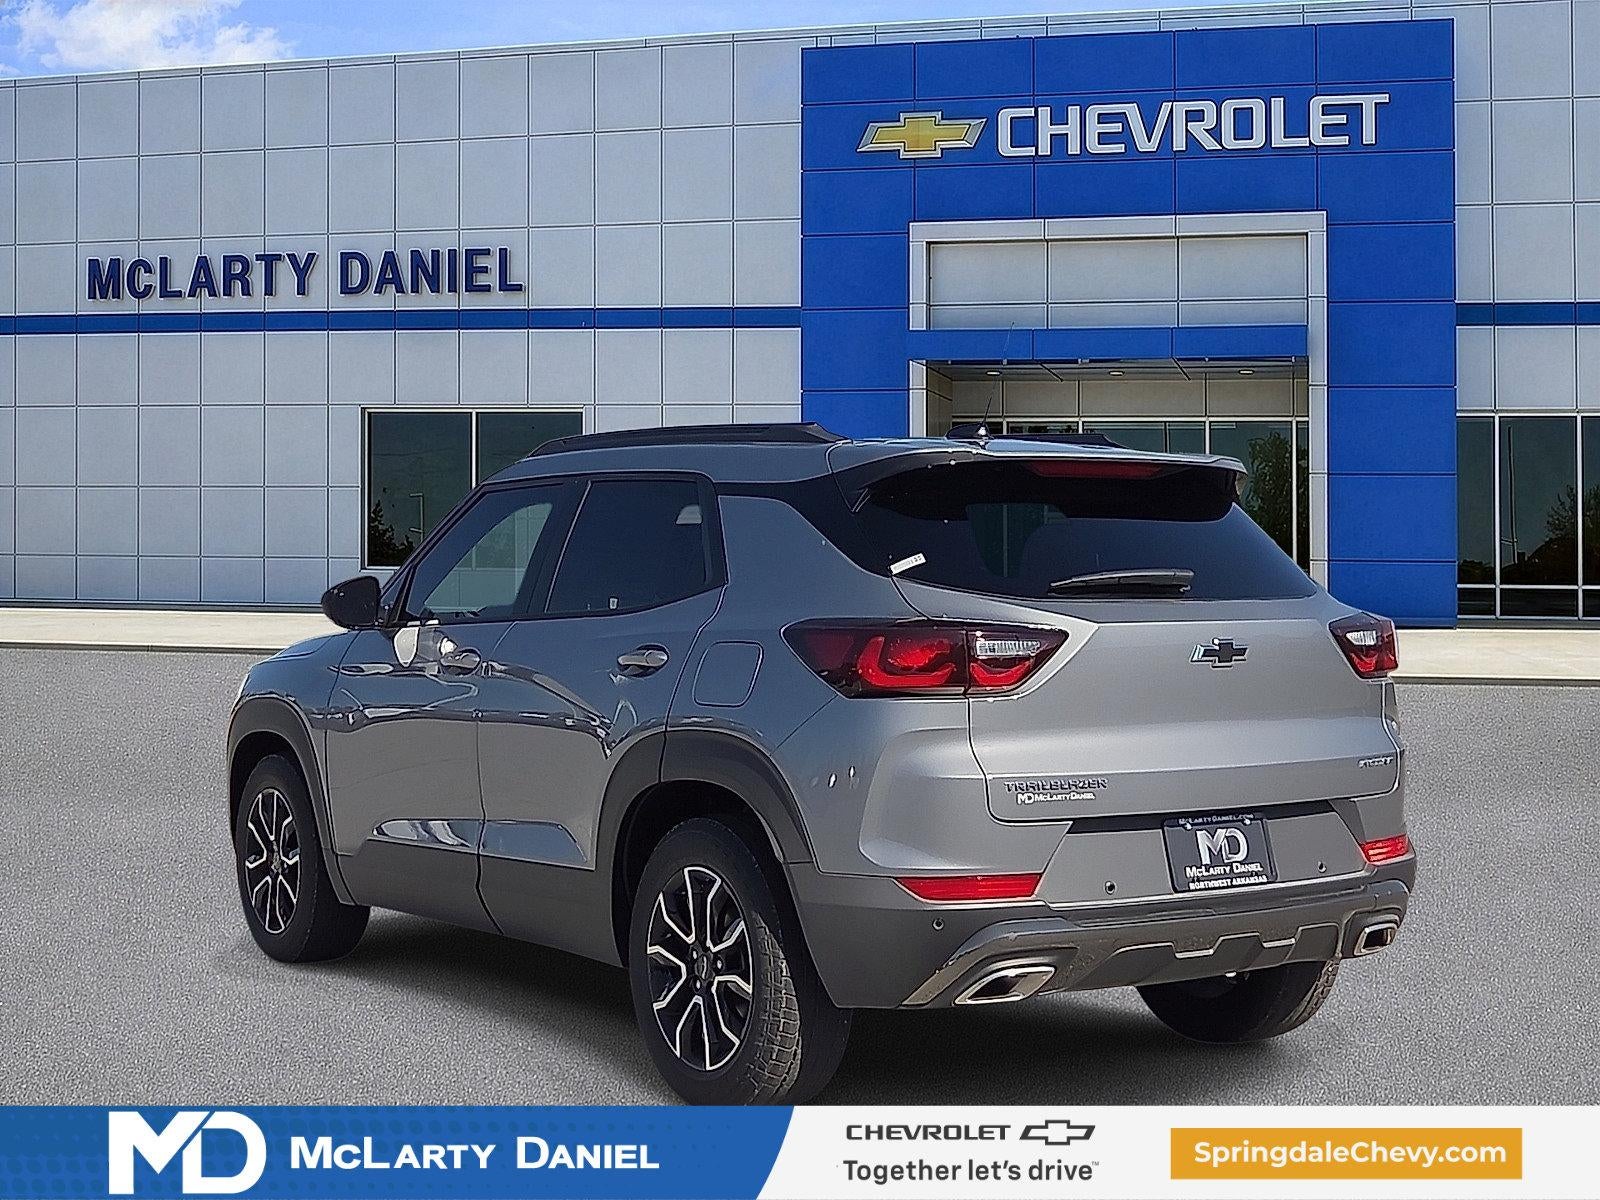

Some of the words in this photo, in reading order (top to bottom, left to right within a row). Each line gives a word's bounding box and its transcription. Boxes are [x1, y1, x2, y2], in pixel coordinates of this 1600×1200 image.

[996, 93, 1389, 157] CHEVROLET
[339, 246, 525, 295] DANIEL
[1004, 778, 1108, 793] TRAILBLAZER
[1196, 828, 1249, 865] MD
[1232, 862, 1263, 873] DANIEL
[1189, 878, 1232, 890] NORTHWEST
[1231, 874, 1268, 886] ARKANSAS
